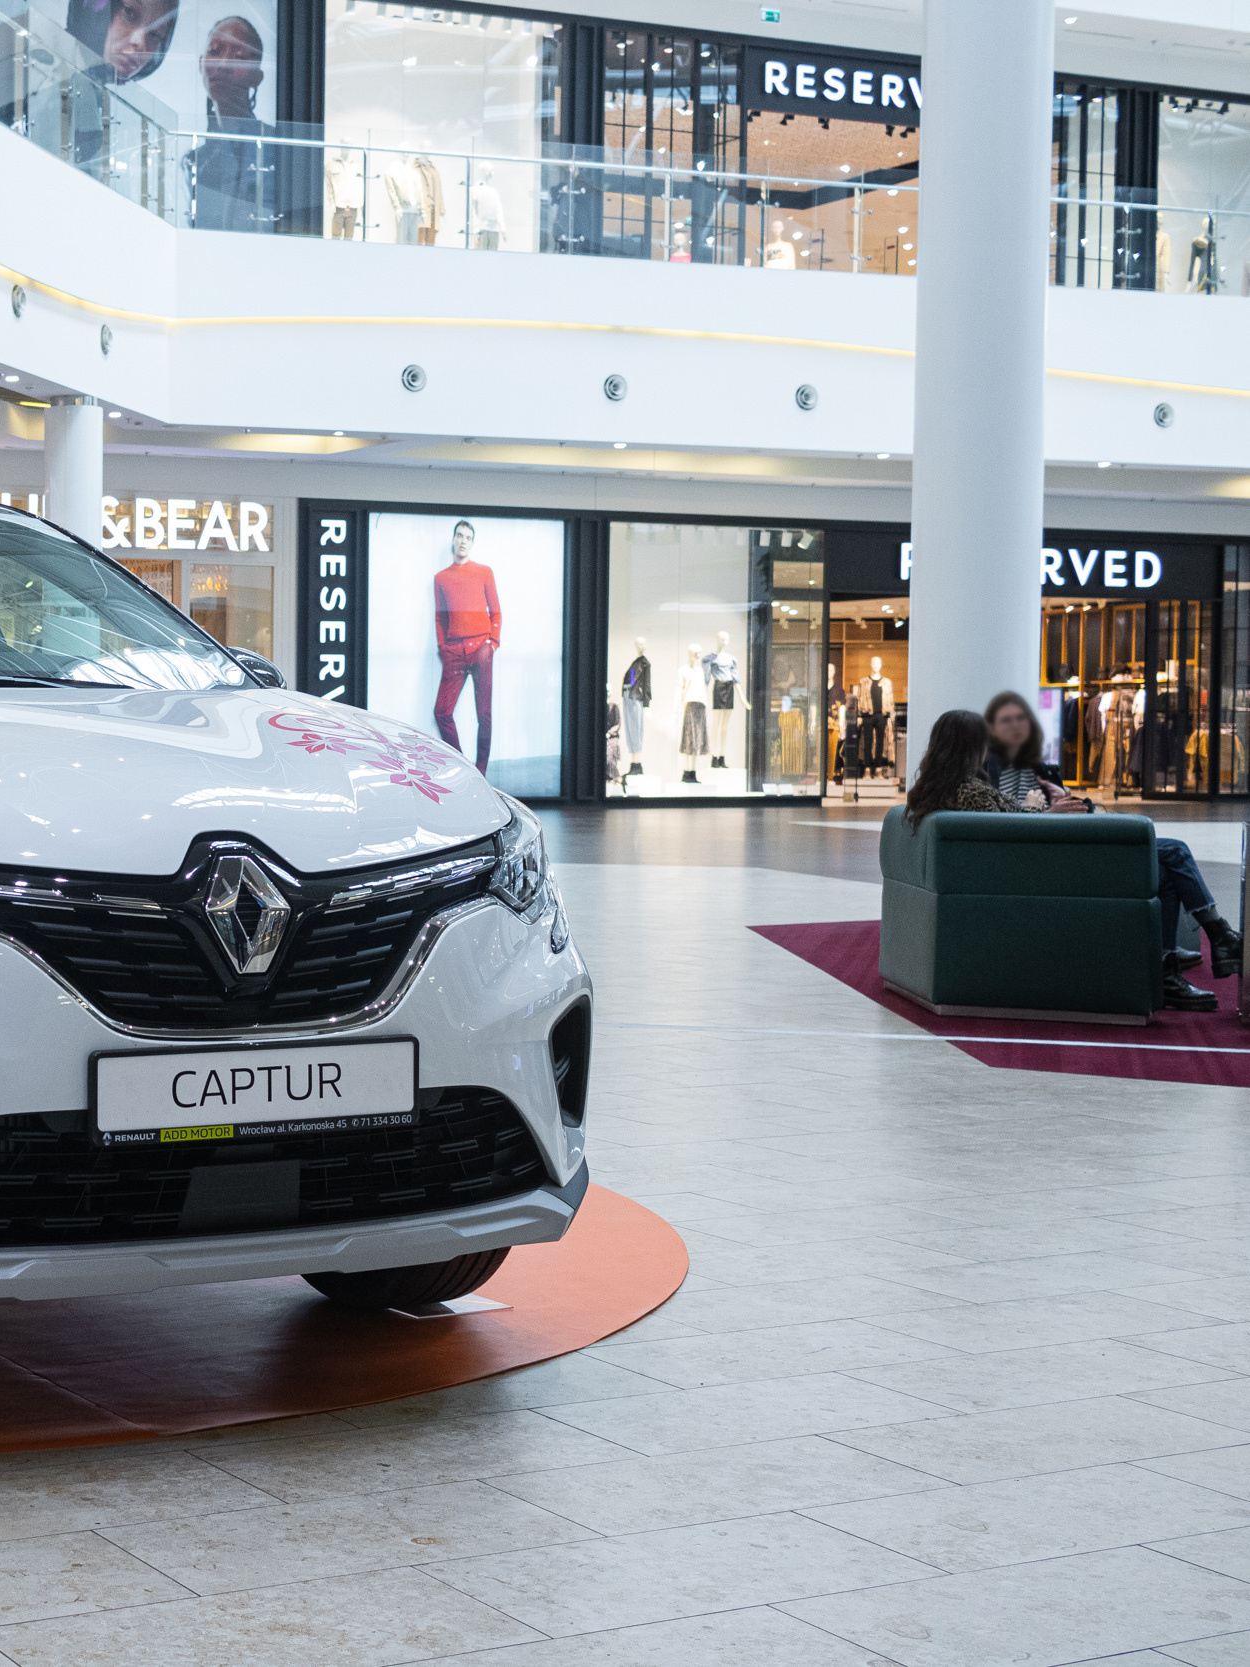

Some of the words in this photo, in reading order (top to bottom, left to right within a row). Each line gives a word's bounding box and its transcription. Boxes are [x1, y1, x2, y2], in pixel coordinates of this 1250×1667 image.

[172, 1062, 342, 1108] CAPTUR
[114, 1132, 156, 1142] RENAULT
[163, 1129, 188, 1140] ADD
[190, 1126, 231, 1139] MOTOR
[239, 1124, 276, 1135] Wrocław
[277, 1123, 287, 1133] al.
[288, 1121, 335, 1132] Karkonoska
[336, 1119, 347, 1129] 45
[360, 1117, 370, 1127] 71
[372, 1116, 389, 1126] 334
[389, 1115, 400, 1125] 30
[401, 1114, 412, 1124] 60
